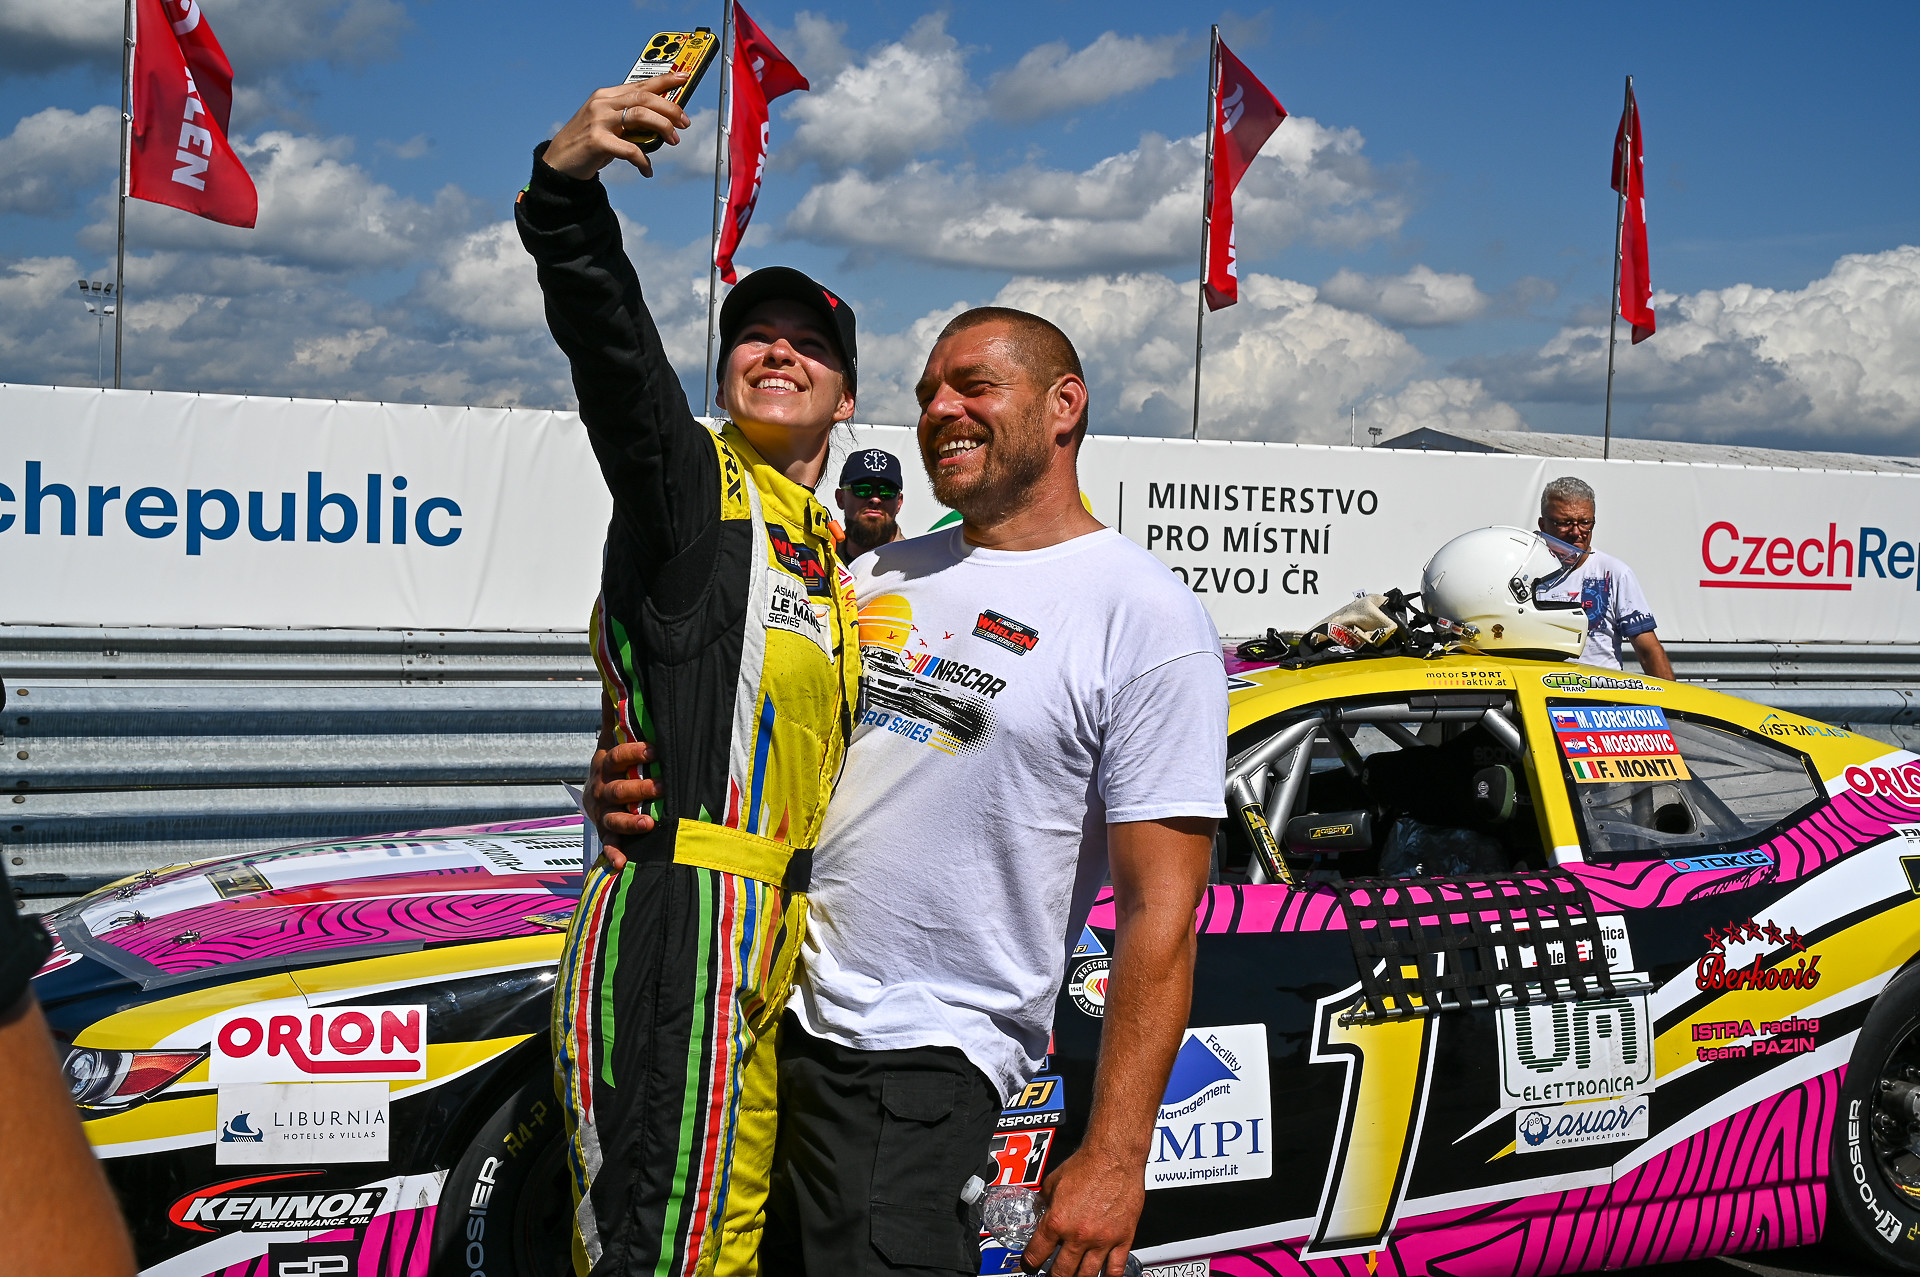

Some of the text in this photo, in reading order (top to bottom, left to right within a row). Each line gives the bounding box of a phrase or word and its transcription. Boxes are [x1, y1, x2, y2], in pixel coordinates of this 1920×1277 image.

[171, 66, 213, 192] LEN
[1148, 482, 1378, 516] MINISTERSTVO
[1147, 522, 1331, 554] PRO MÍSTNÍ
[1701, 521, 1920, 591] CzechRe
[774, 584, 798, 600] ASIAN
[1170, 563, 1319, 595] OZVOJ ČR
[771, 595, 790, 614] LE
[767, 612, 800, 629] SERIES
[978, 614, 1038, 650] WHELEN
[930, 658, 1007, 700] NASCAR
[1466, 678, 1507, 686] aktiv.at
[888, 717, 933, 744] SERIES
[1577, 709, 1663, 729] M. DORCIKOVA
[1588, 733, 1674, 754] S. MOGOROVIC
[1600, 758, 1678, 779] F. MONTI
[1845, 766, 1920, 805] ORIO
[1077, 960, 1109, 980] NASCAR
[1696, 952, 1822, 991] Berković
[1078, 996, 1105, 1015] ANNIV
[218, 1009, 421, 1074] ORION
[1691, 1015, 1820, 1041] ISTRA racing
[1205, 1033, 1242, 1072] Facility
[1697, 1036, 1816, 1062] team PAZIN
[1156, 1082, 1231, 1120] Management
[1523, 1075, 1635, 1102] ELETTRONICA
[1299, 945, 1444, 1261] 1
[274, 1109, 385, 1127] LIBURNIA
[996, 1112, 1061, 1128] RSPORTS
[283, 1131, 376, 1141] HOTELS & VILLAS
[1146, 1118, 1264, 1164] MPI
[1154, 1164, 1239, 1182] www.impisrl.it
[1848, 1099, 1885, 1222] HOOSIER
[182, 1192, 374, 1222] KENNOL
[466, 1156, 504, 1277] OSIER
[251, 1216, 370, 1229] PERFORMANCE OIL
